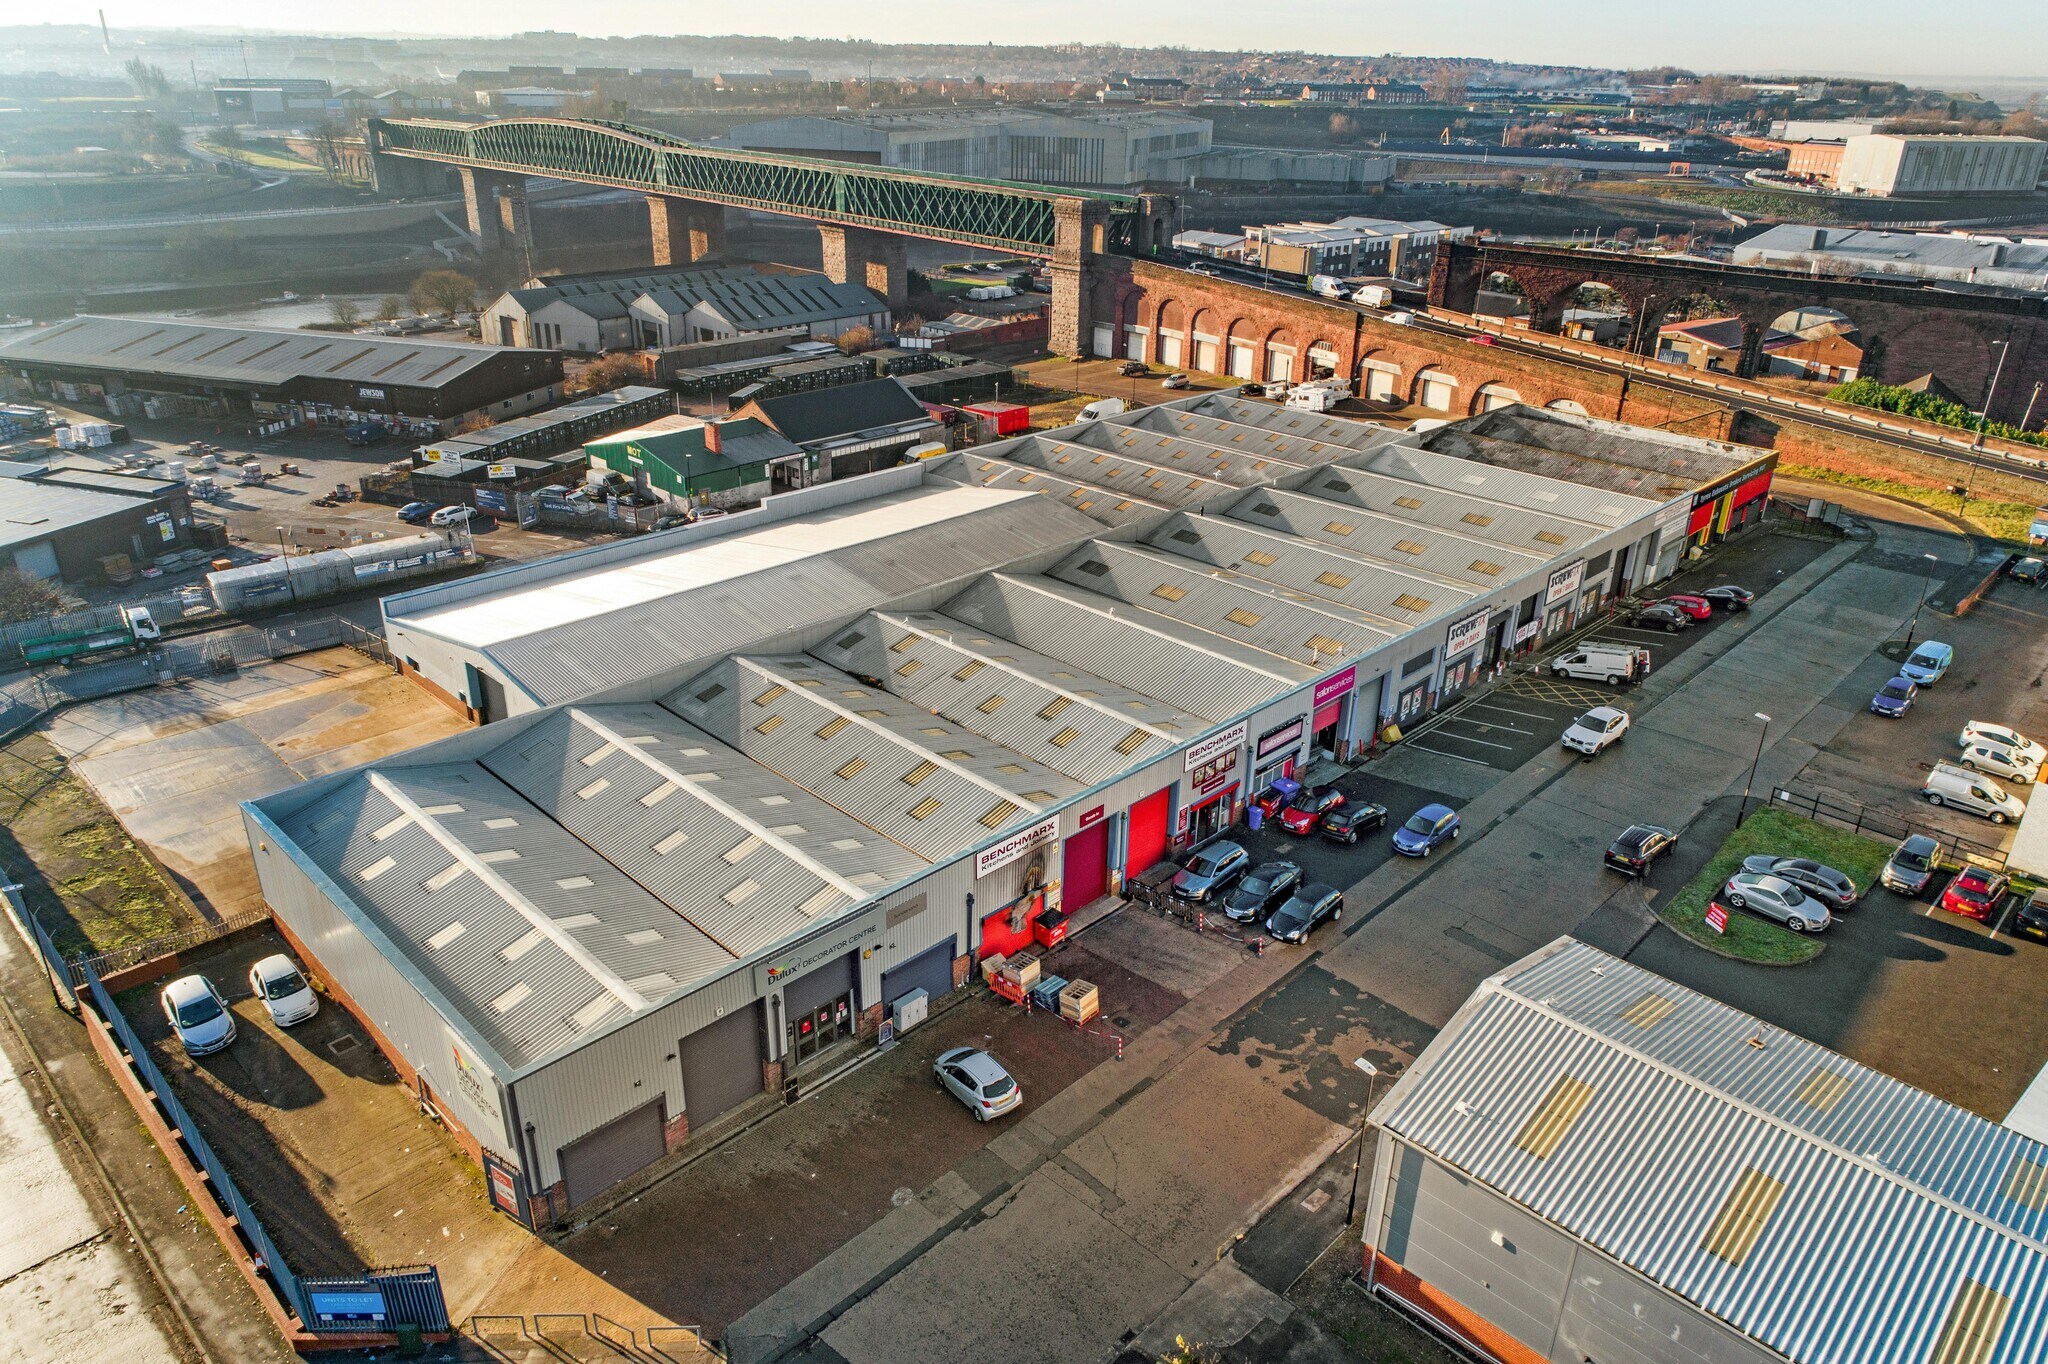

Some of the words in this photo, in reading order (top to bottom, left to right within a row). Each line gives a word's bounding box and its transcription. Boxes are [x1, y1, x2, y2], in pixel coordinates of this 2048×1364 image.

[359, 388, 384, 397] JEWSON
[627, 445, 641, 457] MOT
[1453, 640, 1465, 651] OPEN
[1469, 631, 1480, 643] DAYS
[1316, 674, 1353, 699] salonservices
[1189, 726, 1244, 759] BENCHMARX
[1189, 751, 1213, 765] Kitchens
[1214, 744, 1224, 752] and
[1225, 735, 1244, 747] Joinery
[981, 852, 1014, 871] Kitchens
[1016, 844, 1029, 854] and
[1031, 831, 1055, 847] Joinery
[982, 822, 1055, 865] BENCHMARX
[767, 964, 797, 986] Dulux
[802, 940, 848, 968] DECORATOR
[848, 924, 877, 945] CENTRE
[454, 1055, 480, 1091] Dulux
[457, 1070, 499, 1121] DECORATOR
[459, 1081, 487, 1116] CENTRE
